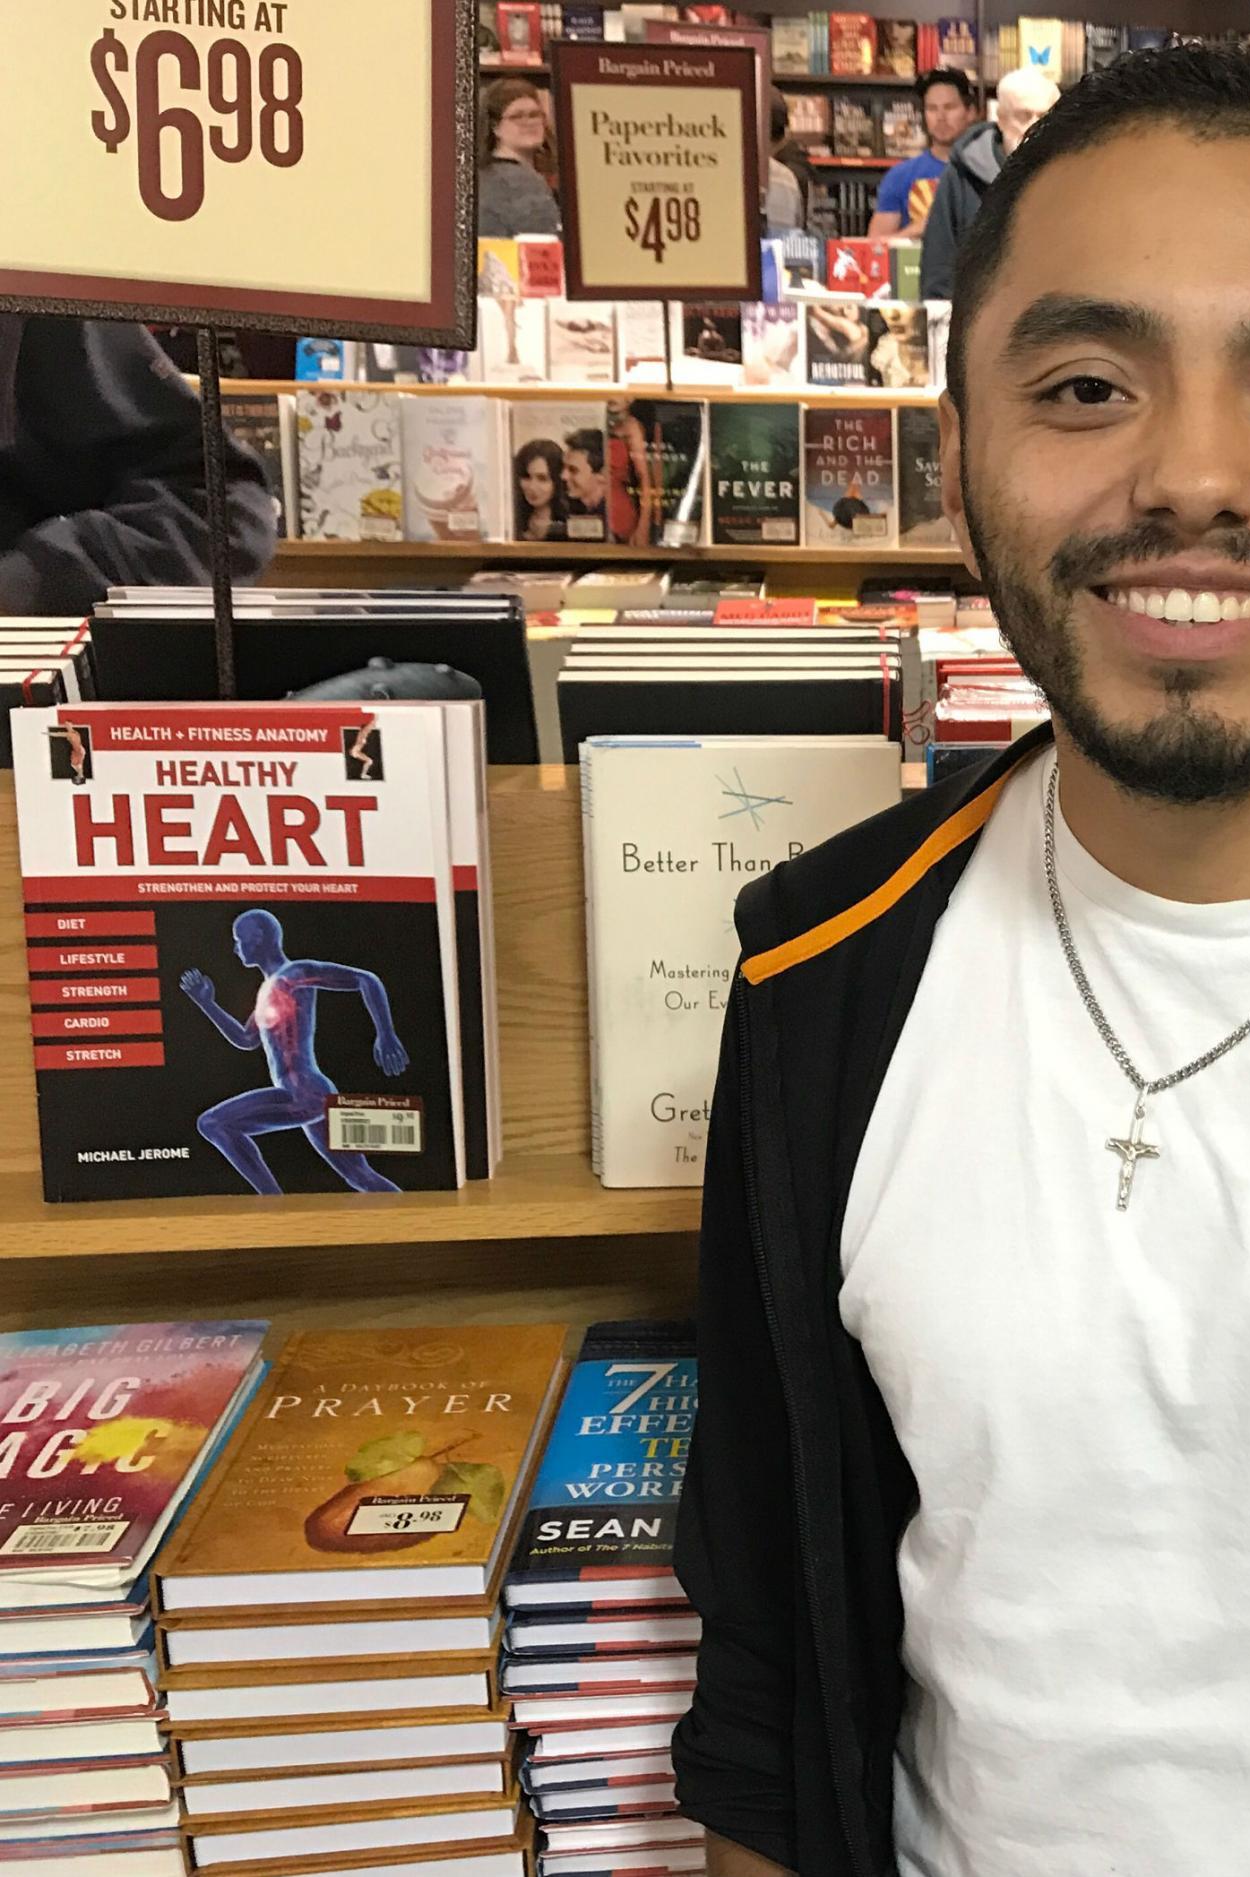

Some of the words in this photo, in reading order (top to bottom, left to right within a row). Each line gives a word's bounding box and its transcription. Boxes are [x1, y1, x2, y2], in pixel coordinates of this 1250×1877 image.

[110, 0, 246, 30] STARTING
[254, 2, 288, 34] AT
[598, 56, 660, 79] Bargain
[663, 59, 715, 77] Priced
[590, 110, 727, 145] Paperback
[603, 140, 719, 168] Favorites
[630, 182, 680, 194] STARTING
[683, 182, 694, 194] AT
[835, 419, 863, 432] THE
[823, 435, 877, 451] RICH
[741, 460, 769, 473] THE
[816, 455, 848, 467] AND
[856, 456, 884, 467] THE
[821, 470, 880, 487] DEAD
[718, 480, 793, 498] FEVER
[110, 726, 172, 741] HEALTH
[188, 727, 252, 742] FITNESS
[256, 728, 328, 743] ANATOMY
[156, 760, 298, 787] HEALTHY
[72, 794, 379, 868] HEART
[622, 843, 699, 873] Better
[712, 842, 771, 872] Than
[137, 882, 213, 895] STRENGTHEN
[215, 883, 239, 894] AND
[241, 883, 289, 894] PROTECT
[291, 883, 320, 894] YOUR
[322, 883, 359, 894] HEART
[57, 918, 86, 930] DIET
[60, 953, 125, 965] LIFESTYLE
[650, 960, 730, 982] Mastering
[61, 985, 128, 998] STRENGTH
[665, 990, 699, 1010] Our
[64, 1017, 110, 1029] CARDIO
[66, 1049, 122, 1061] STRETCH
[337, 1095, 377, 1108] Bargain
[378, 1097, 411, 1107] Priced
[78, 1150, 136, 1163] MICHAEL
[138, 1147, 190, 1161] JEROME
[675, 1146, 698, 1163] The
[136, 1335, 242, 1354] GILBERT
[313, 1384, 326, 1394] A
[340, 1381, 448, 1393] DAYBOOK
[461, 1380, 490, 1389] OF
[605, 1363, 678, 1414] 7
[607, 1378, 637, 1388] THE
[1, 1377, 142, 1424] BIG
[264, 1394, 512, 1420] PRAYER
[575, 1413, 692, 1436] EFFE
[371, 1495, 417, 1504] Bargain
[420, 1493, 457, 1503] Priced
[384, 1511, 443, 1530] $8.98
[537, 1518, 662, 1541] SEAN
[530, 1546, 575, 1556] Author
[578, 1544, 592, 1553] of
[596, 1543, 619, 1552] The
